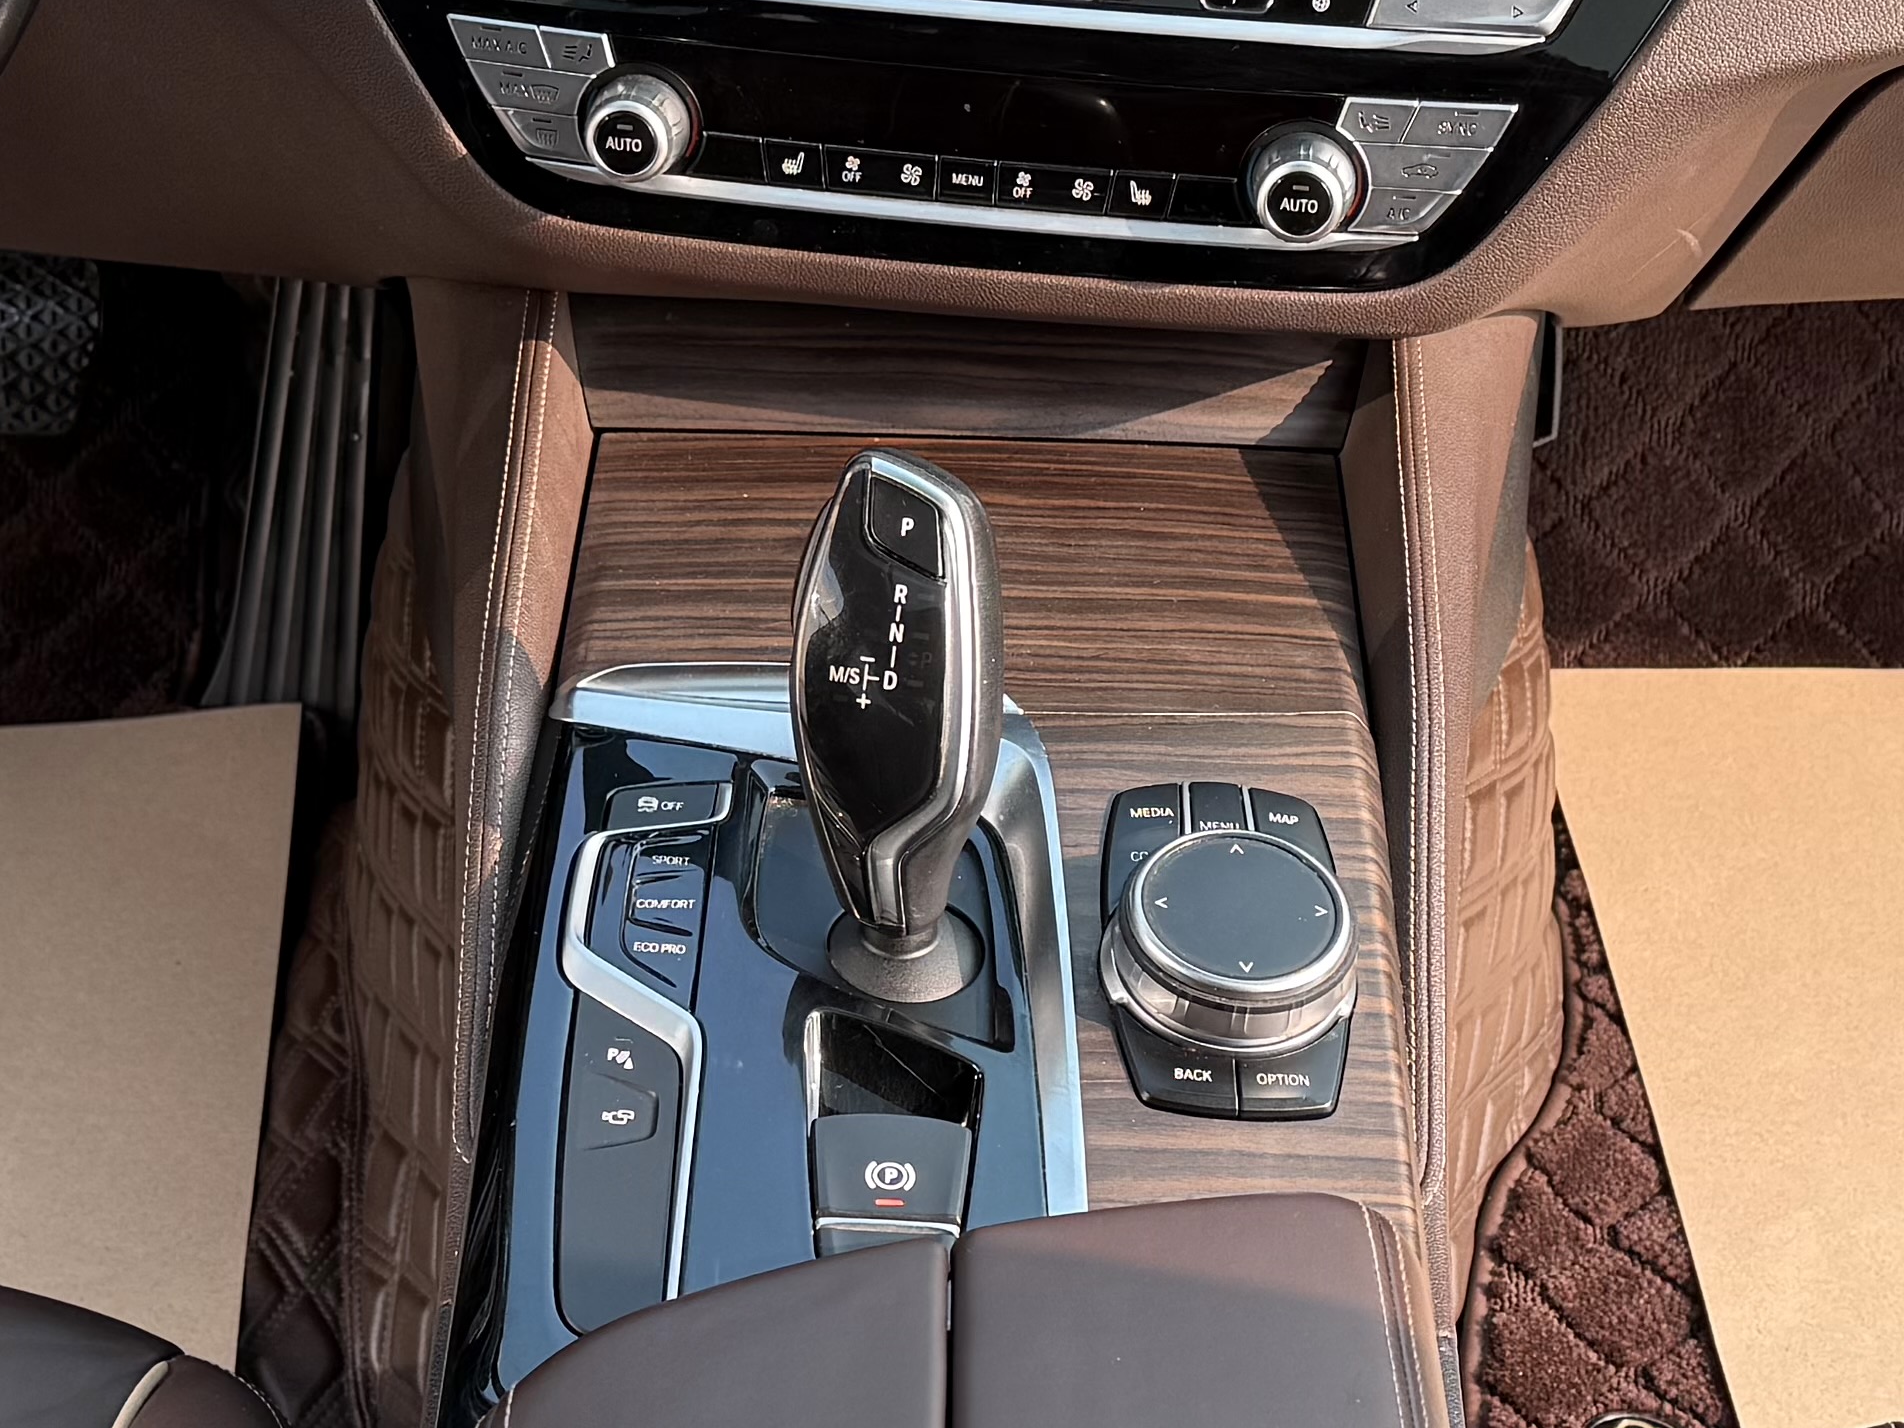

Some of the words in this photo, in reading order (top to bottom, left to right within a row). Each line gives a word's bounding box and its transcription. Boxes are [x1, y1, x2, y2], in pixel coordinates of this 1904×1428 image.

[604, 134, 643, 153] AUTO
[841, 168, 862, 183] OFF
[951, 171, 985, 188] MENU
[1012, 185, 1033, 199] OFF
[1279, 194, 1319, 214] AUTO
[900, 517, 915, 537] P
[893, 584, 908, 605] R
[888, 622, 904, 643] N
[882, 670, 898, 691] D
[660, 801, 685, 812] OFF
[1129, 807, 1175, 818] MEDIA
[1268, 811, 1299, 825] MAP
[651, 854, 691, 866] SPORT
[635, 898, 697, 909] COMFORT
[632, 941, 659, 953] ECO
[660, 942, 687, 955] PRO
[1173, 1067, 1213, 1083] BACK
[1255, 1072, 1311, 1088] OPTION
